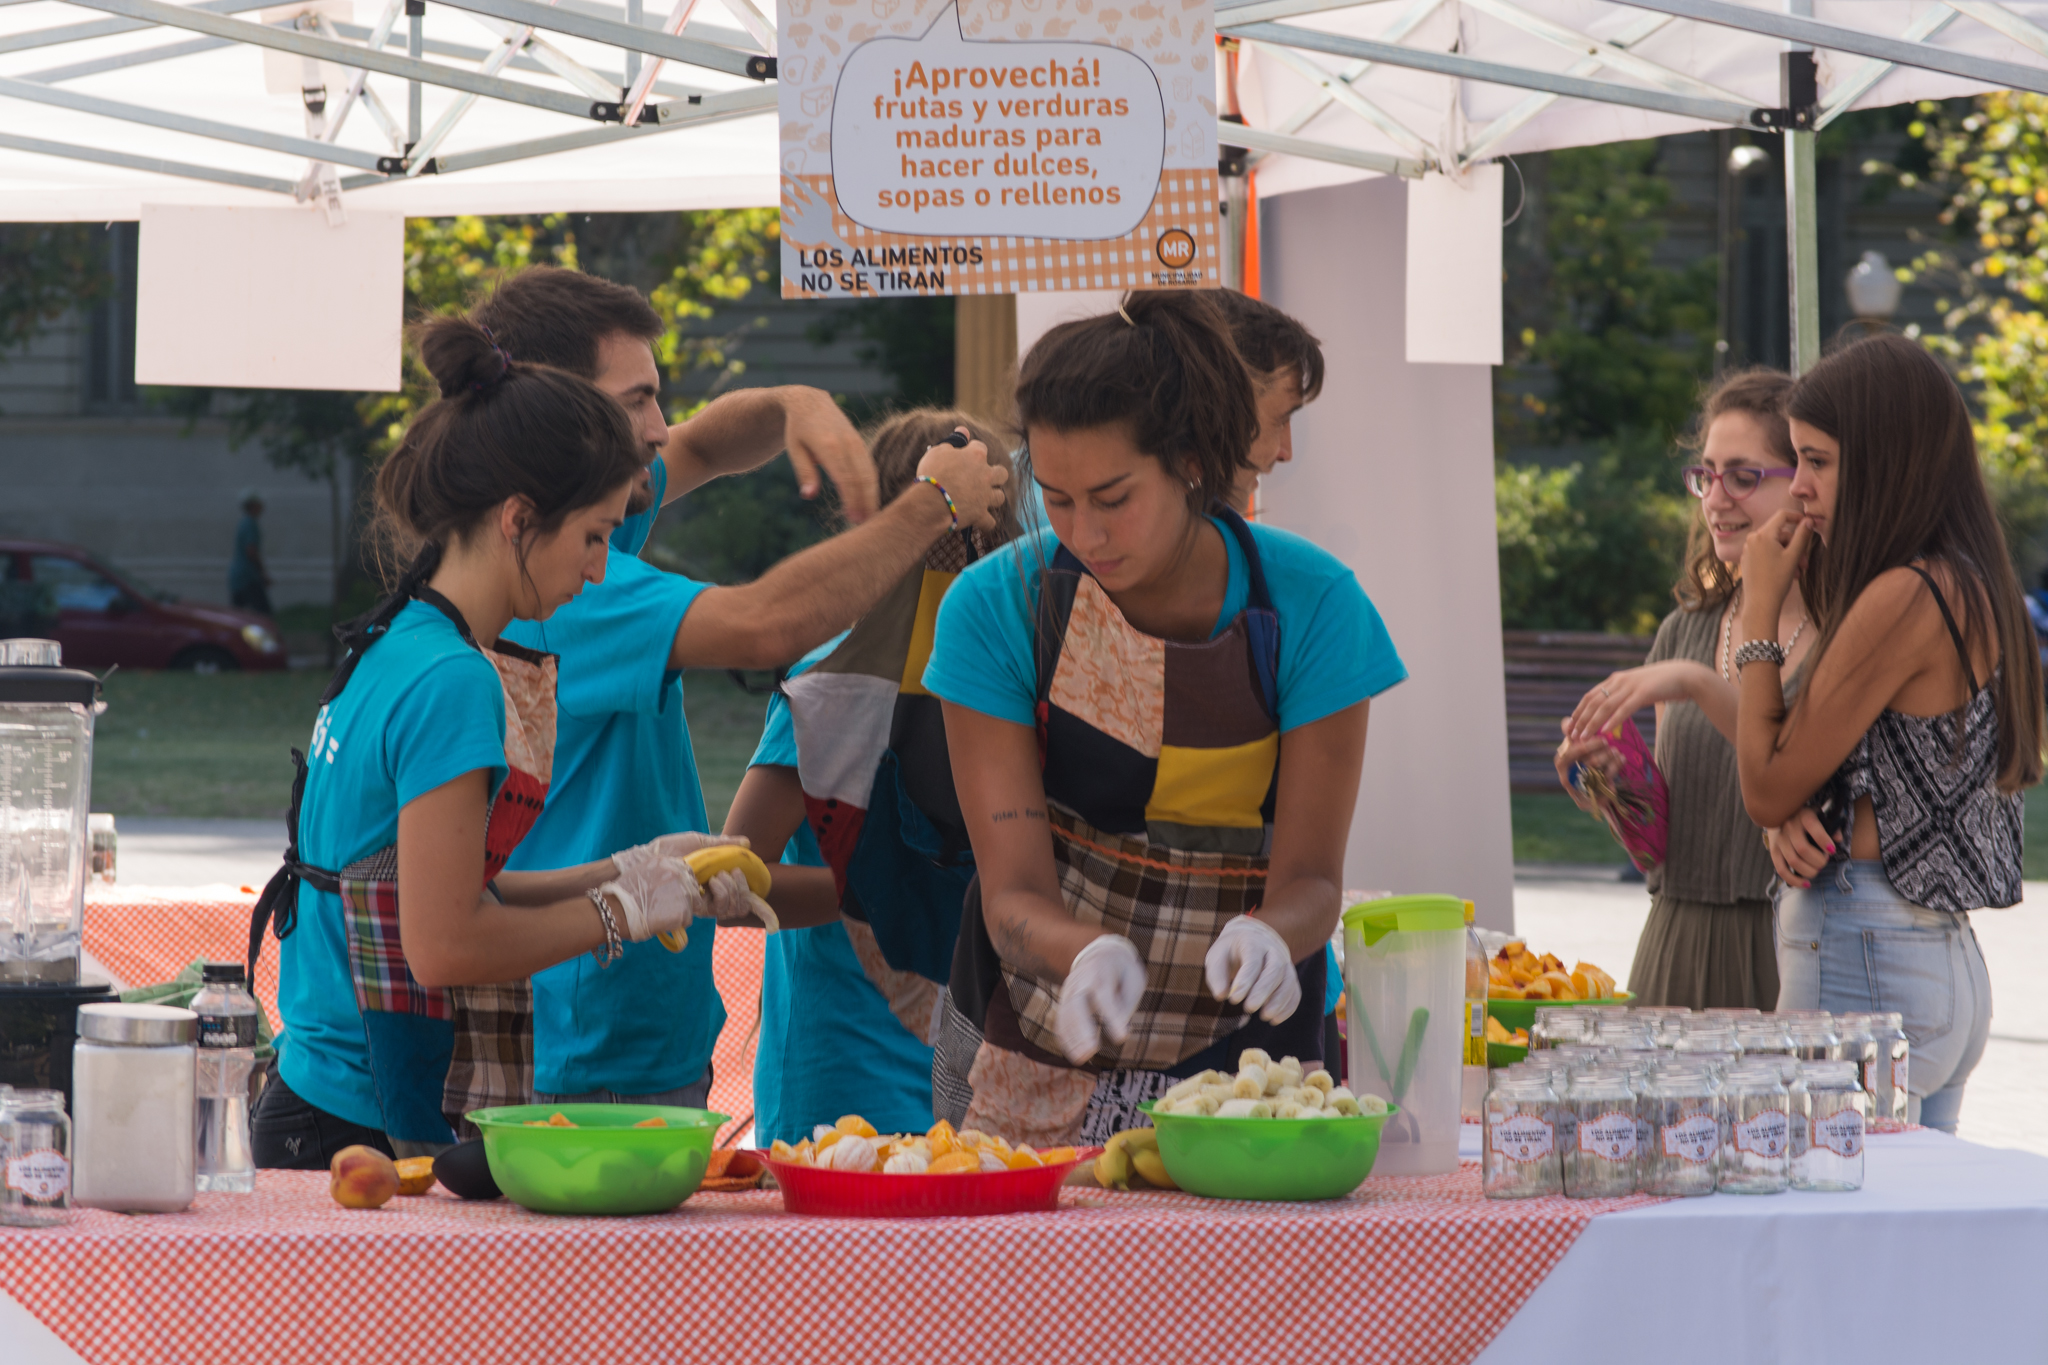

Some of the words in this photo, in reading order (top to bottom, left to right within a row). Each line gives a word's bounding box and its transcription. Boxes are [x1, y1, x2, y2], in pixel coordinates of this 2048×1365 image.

[894, 57, 1101, 98] ¡Aprovechá!
[873, 95, 963, 120] frutas
[972, 100, 988, 124] y
[998, 92, 1129, 118] verduras
[895, 123, 1026, 149] maduras
[1036, 128, 1102, 152] para
[901, 153, 984, 178] hacer
[993, 151, 1098, 180] dulces,
[878, 188, 965, 213] sopas
[974, 187, 991, 206] o
[1000, 180, 1122, 206] rellenos
[800, 248, 844, 268] LOS
[851, 246, 984, 267] ALIMENTOS
[1163, 240, 1190, 258] MR
[801, 271, 833, 292] NO
[840, 271, 869, 291] SE
[875, 271, 945, 290] TIRAN
